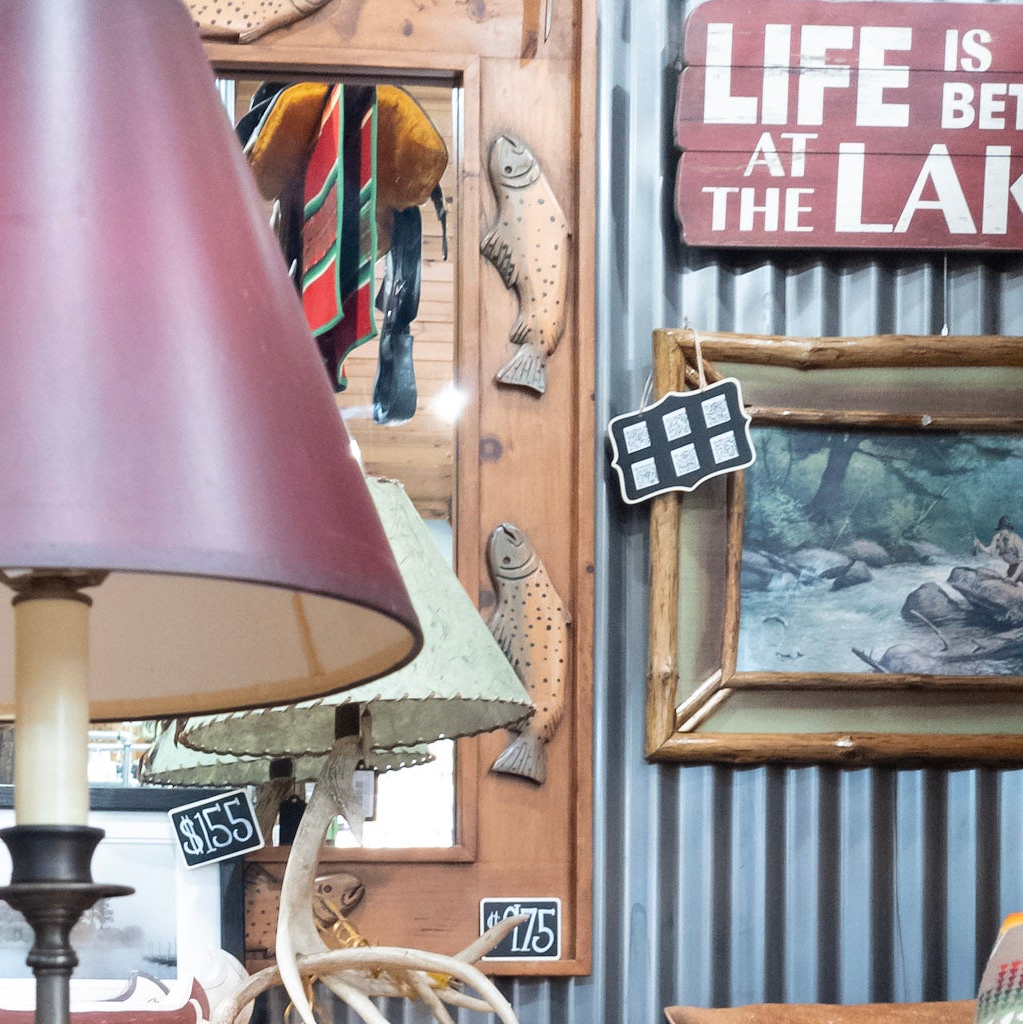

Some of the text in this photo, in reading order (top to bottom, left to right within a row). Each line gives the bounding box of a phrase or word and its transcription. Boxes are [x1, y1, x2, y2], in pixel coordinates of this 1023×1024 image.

[703, 23, 993, 127] LIFE IS
[743, 132, 818, 177] AT
[701, 187, 815, 232] THE
[179, 797, 253, 855] $155
